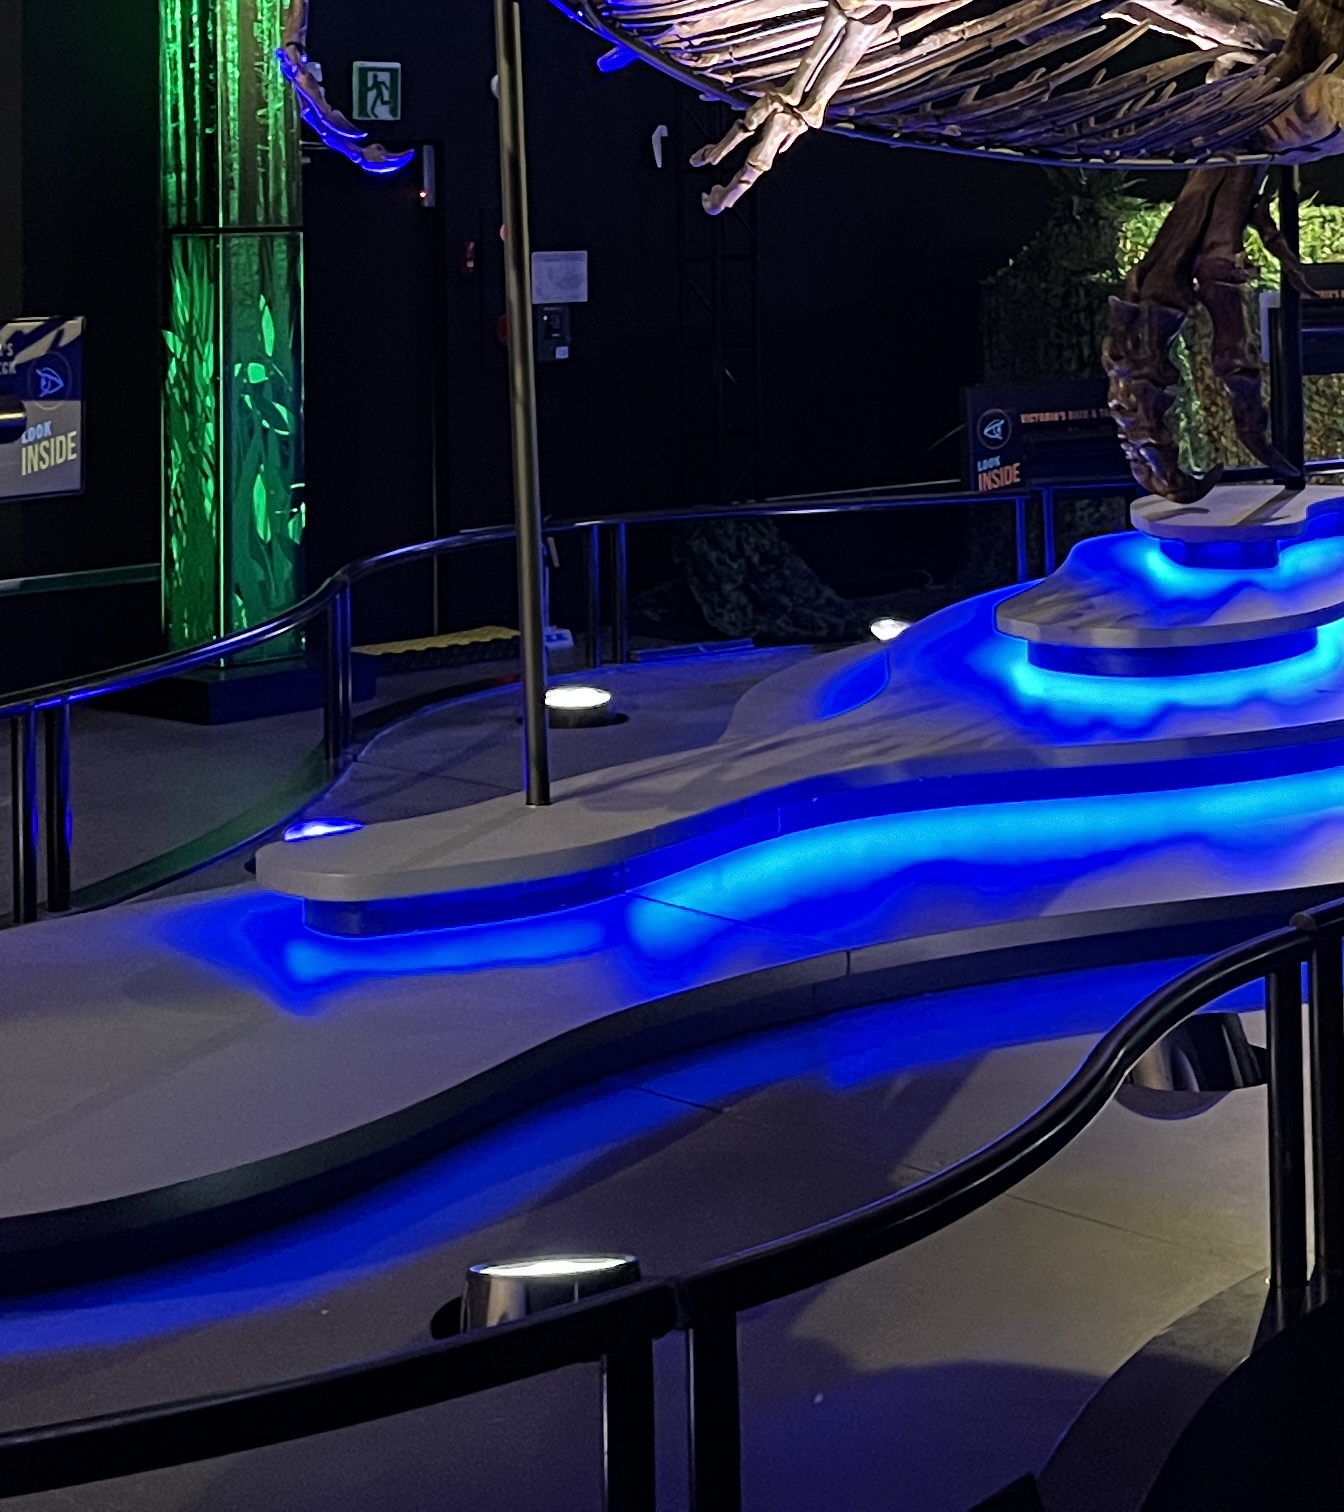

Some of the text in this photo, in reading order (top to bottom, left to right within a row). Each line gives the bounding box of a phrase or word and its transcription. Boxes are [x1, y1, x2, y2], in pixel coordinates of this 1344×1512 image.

[21, 420, 52, 444] LOOK
[21, 431, 77, 476] INSIDE
[976, 455, 1001, 472] LOOK
[978, 461, 1021, 491] INSIDE
